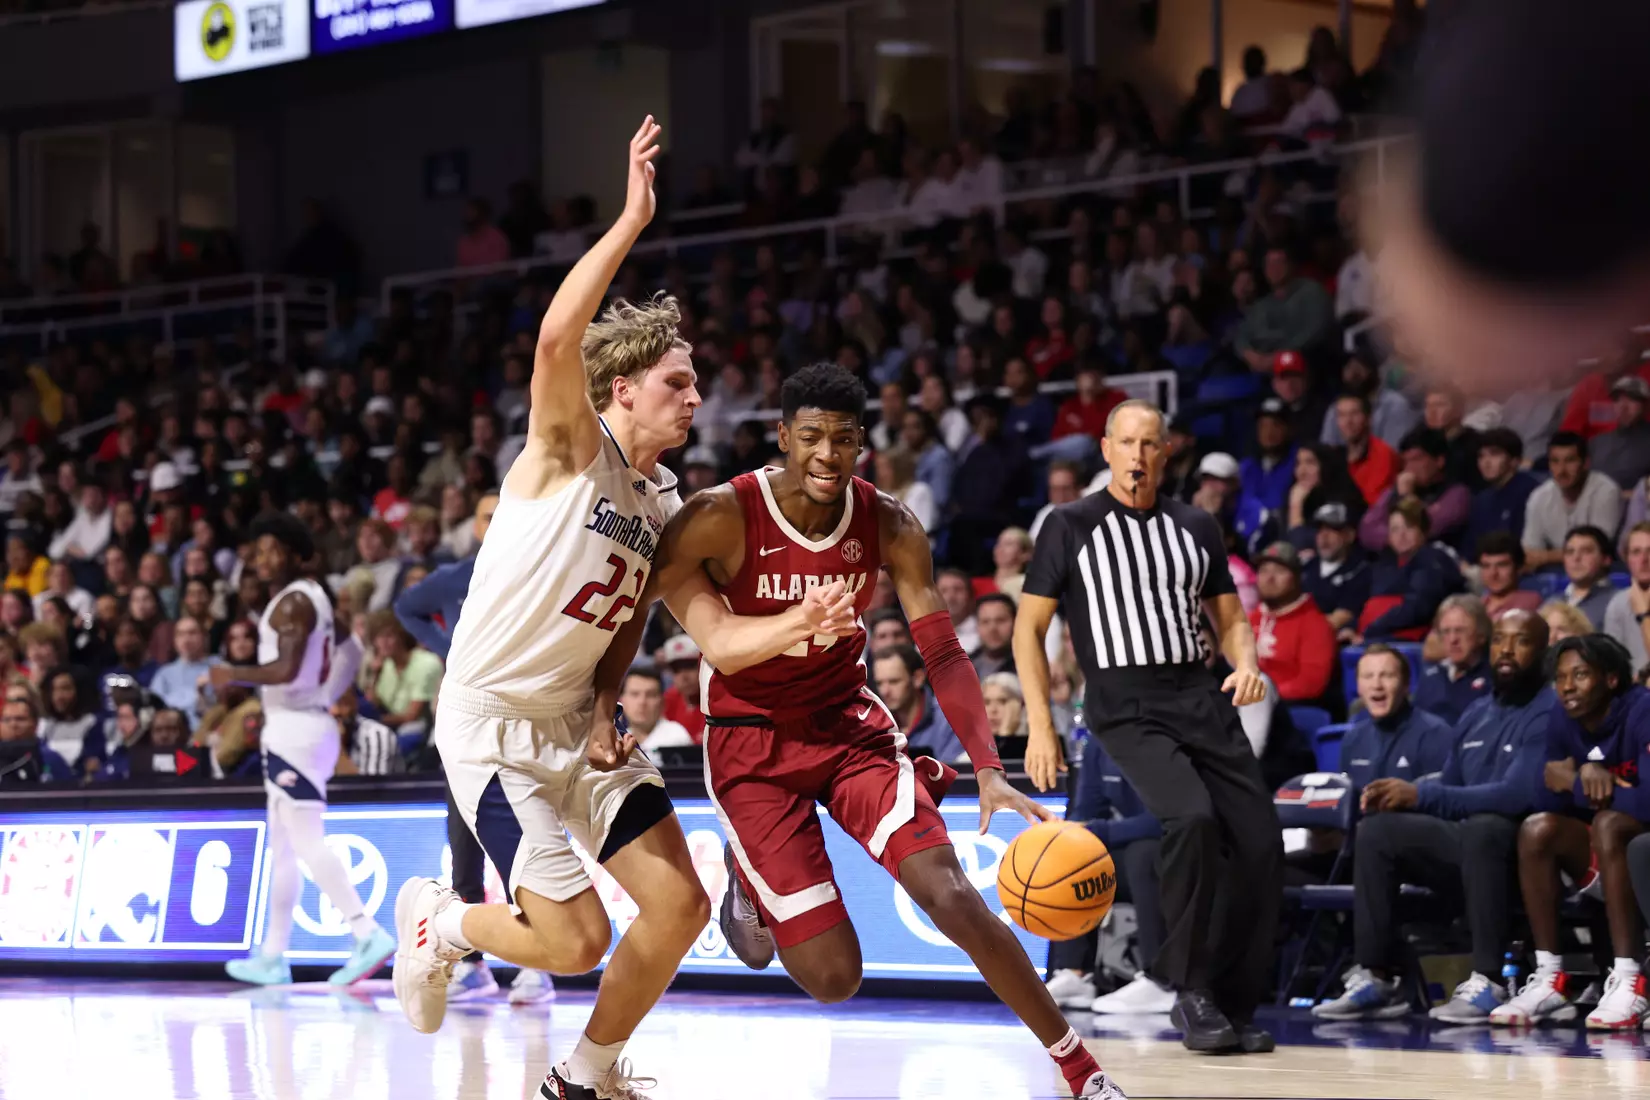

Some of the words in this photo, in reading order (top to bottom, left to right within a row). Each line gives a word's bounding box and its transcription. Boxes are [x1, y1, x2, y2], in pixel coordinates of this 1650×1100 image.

[843, 540, 862, 561] SEC
[561, 552, 644, 632] 22
[190, 840, 232, 926] 6
